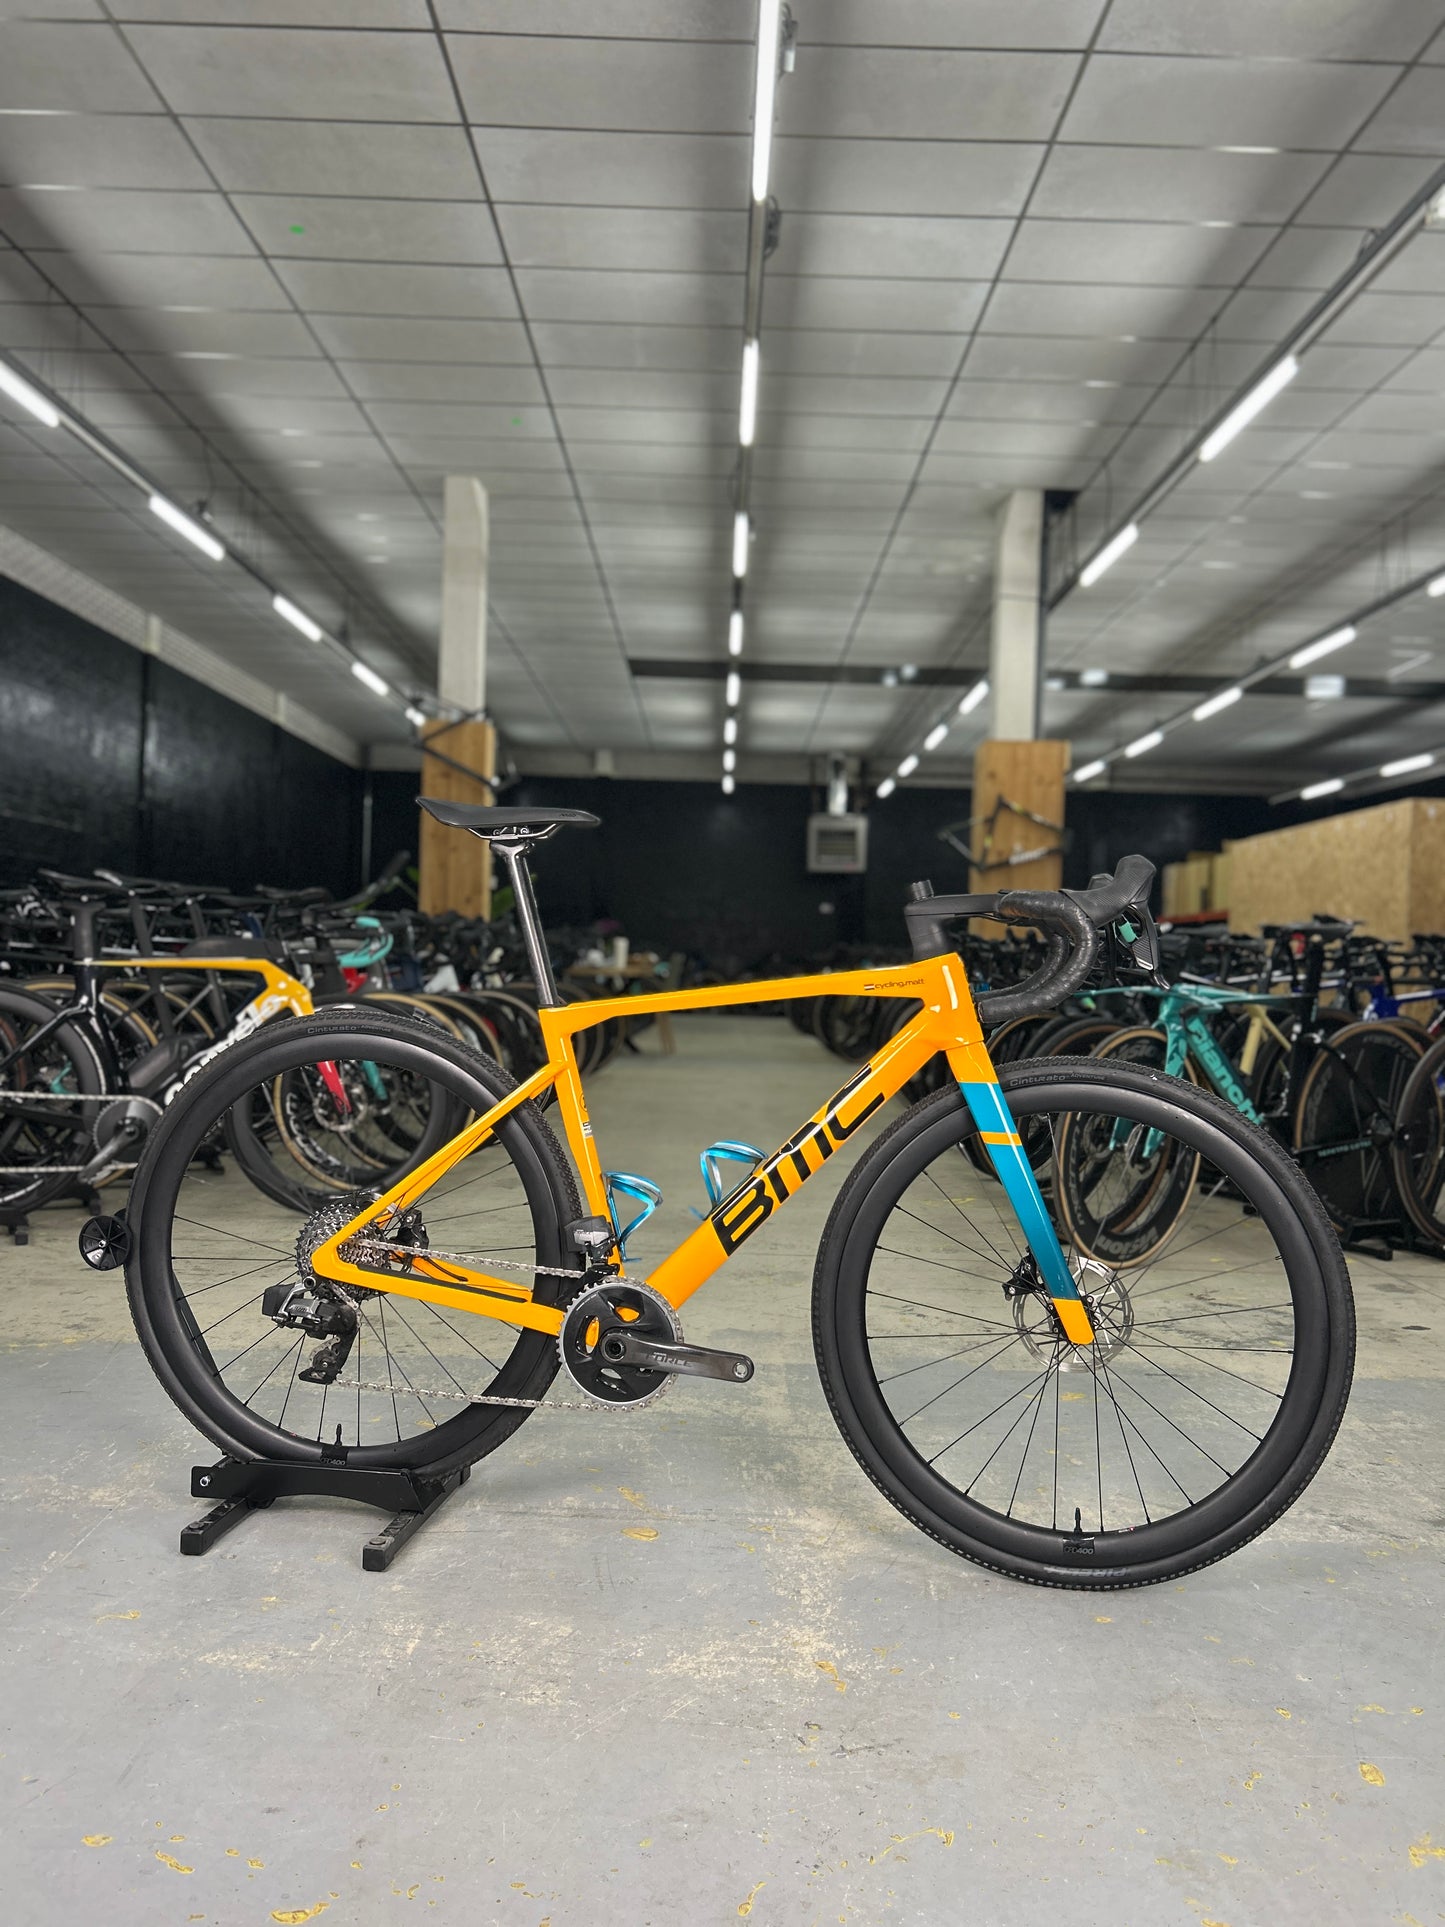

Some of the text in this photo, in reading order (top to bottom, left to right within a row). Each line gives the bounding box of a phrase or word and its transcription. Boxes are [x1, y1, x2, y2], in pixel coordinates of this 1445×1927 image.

[307, 1025, 357, 1034] Cinturato
[1009, 1075, 1066, 1087] Cinturato
[711, 1063, 886, 1257] BMC
